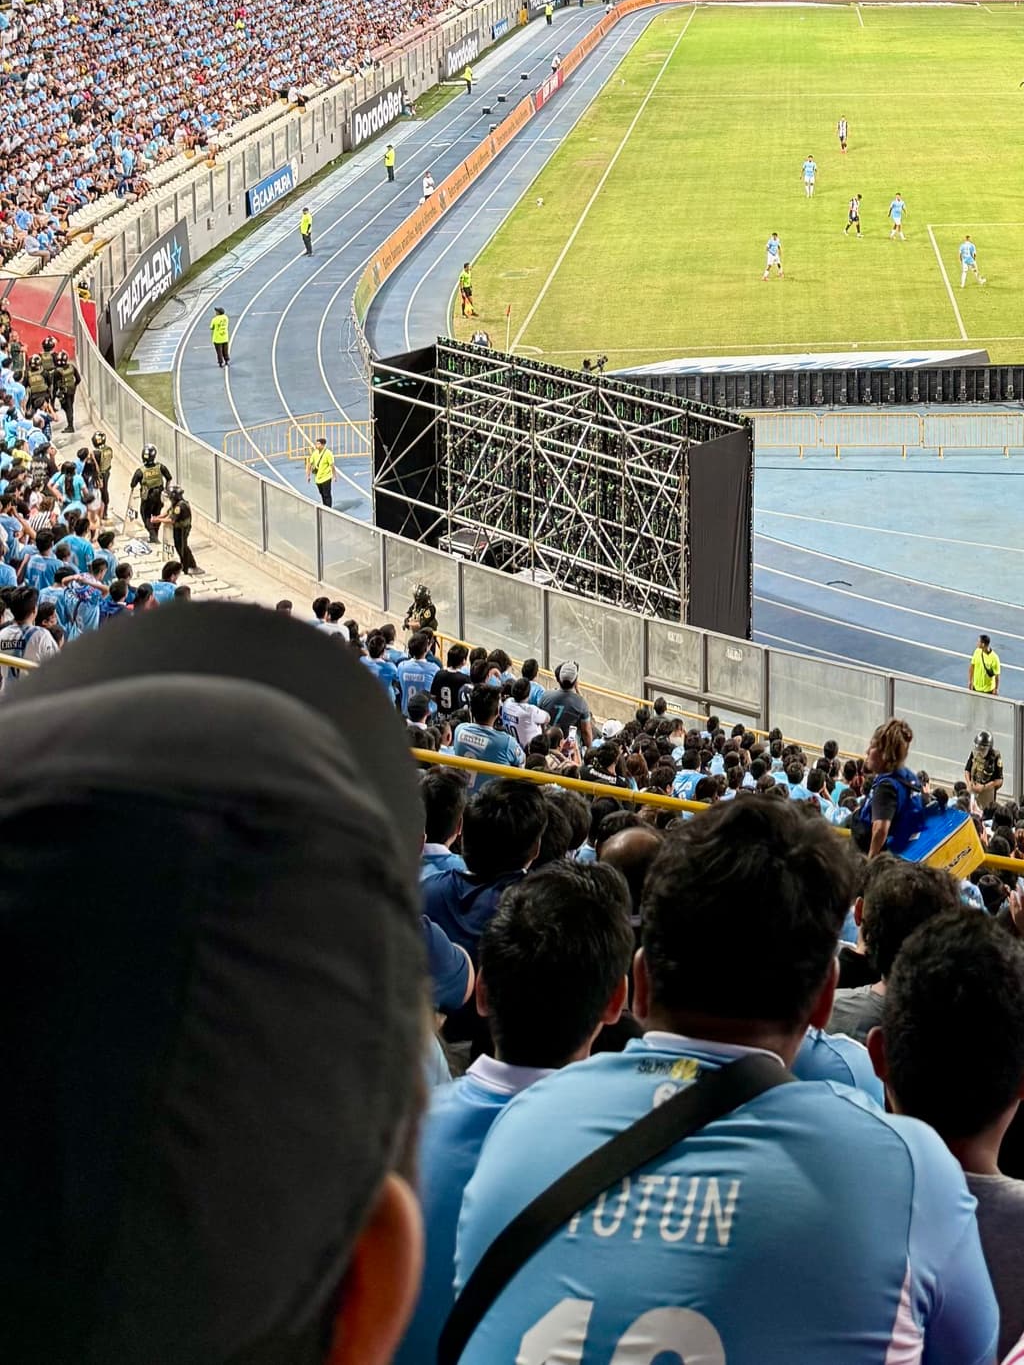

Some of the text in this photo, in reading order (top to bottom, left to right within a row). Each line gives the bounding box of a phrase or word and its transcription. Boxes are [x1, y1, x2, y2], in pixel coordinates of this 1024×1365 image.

[447, 38, 479, 76] DoradoBet
[355, 86, 403, 144] DoradoBet
[258, 171, 292, 208] CAJA PIURA
[117, 242, 172, 330] TRIATHLON
[151, 271, 173, 302] SPORT
[440, 687, 452, 709] 9
[554, 704, 565, 727] 7
[567, 1174, 742, 1248] OTUN
